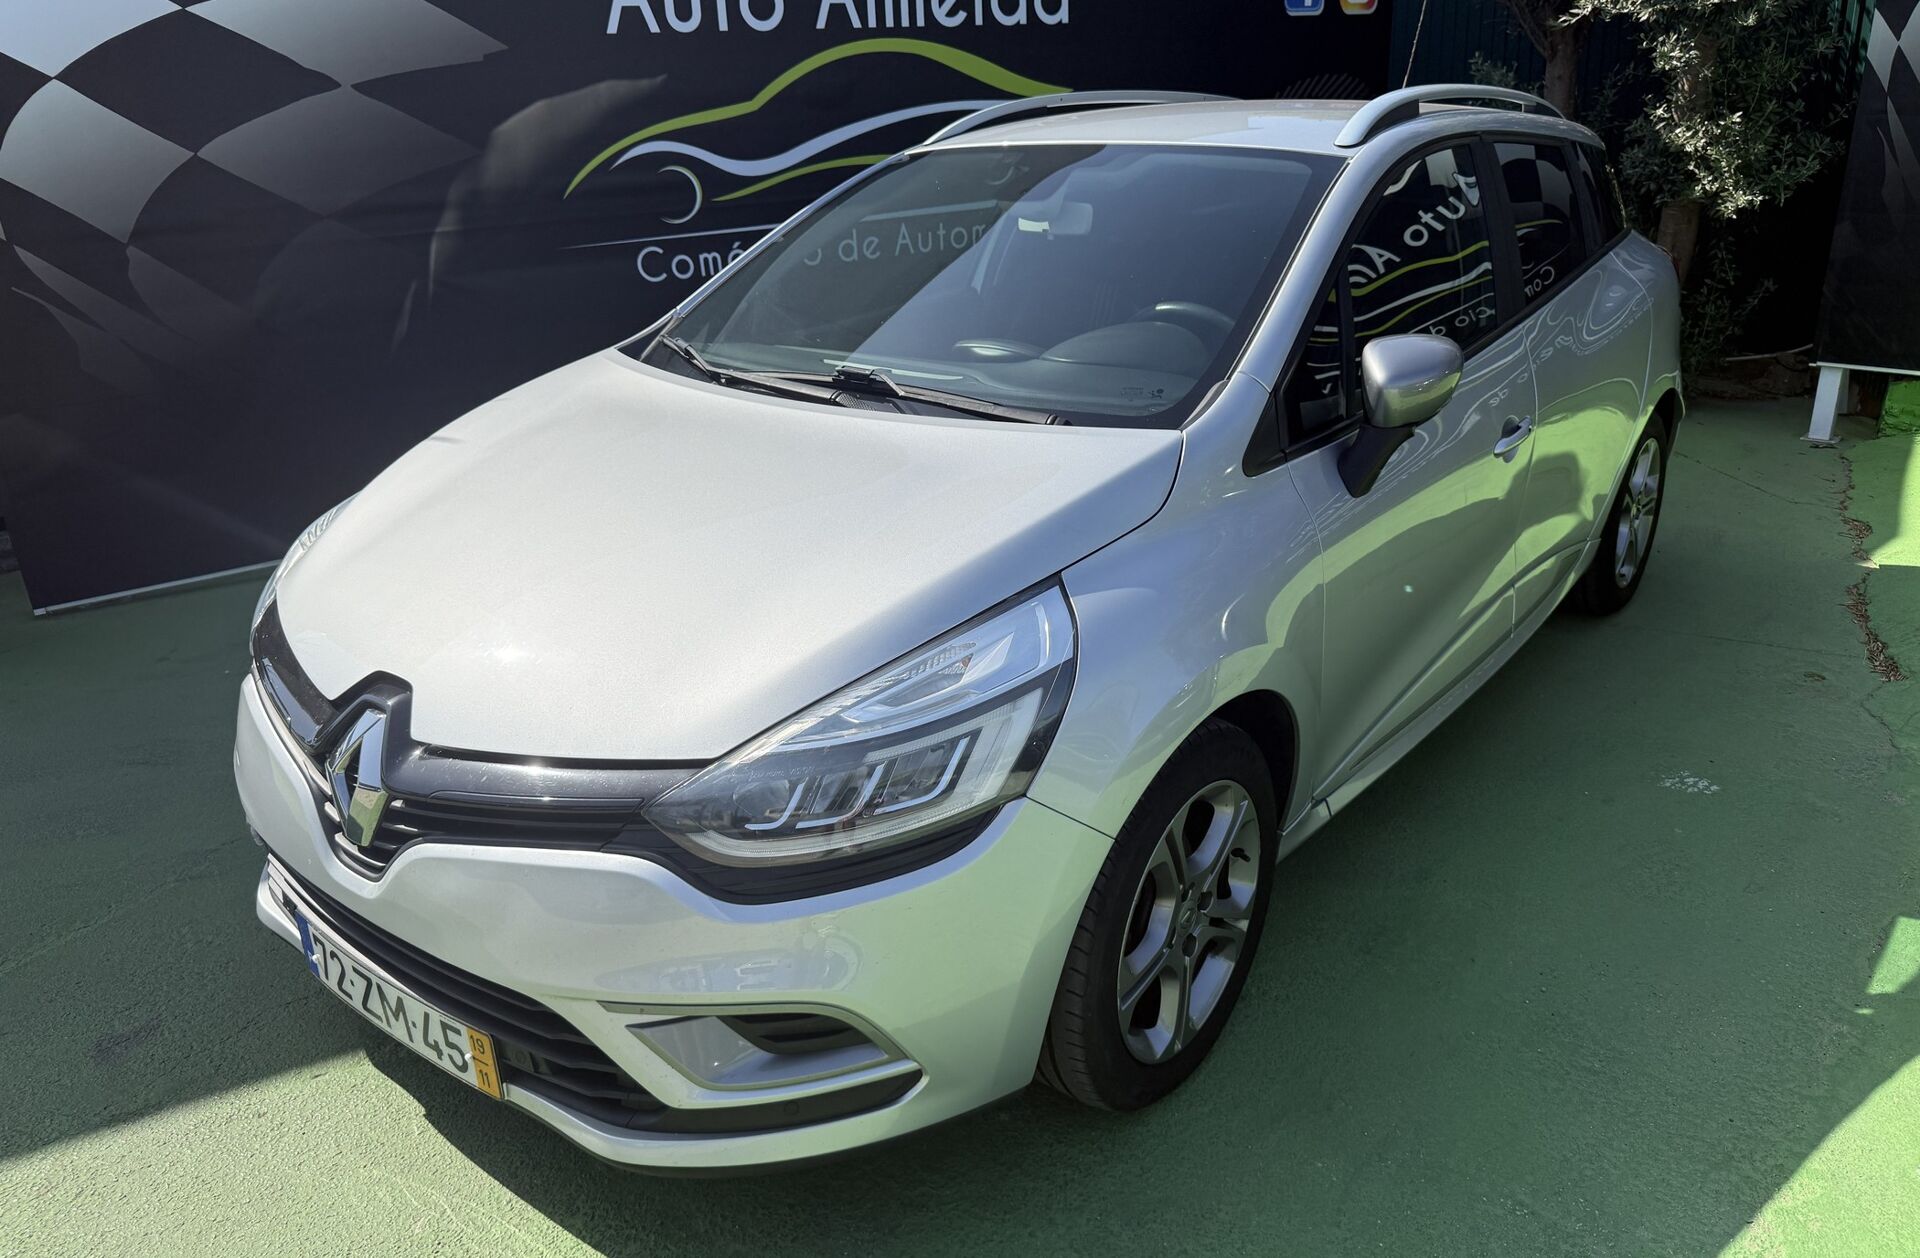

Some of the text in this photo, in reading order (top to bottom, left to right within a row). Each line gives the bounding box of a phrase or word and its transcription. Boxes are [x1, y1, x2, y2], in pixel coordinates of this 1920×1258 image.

[838, 229, 880, 262] de
[470, 1034, 485, 1055] 19
[478, 1069, 491, 1089] 11
